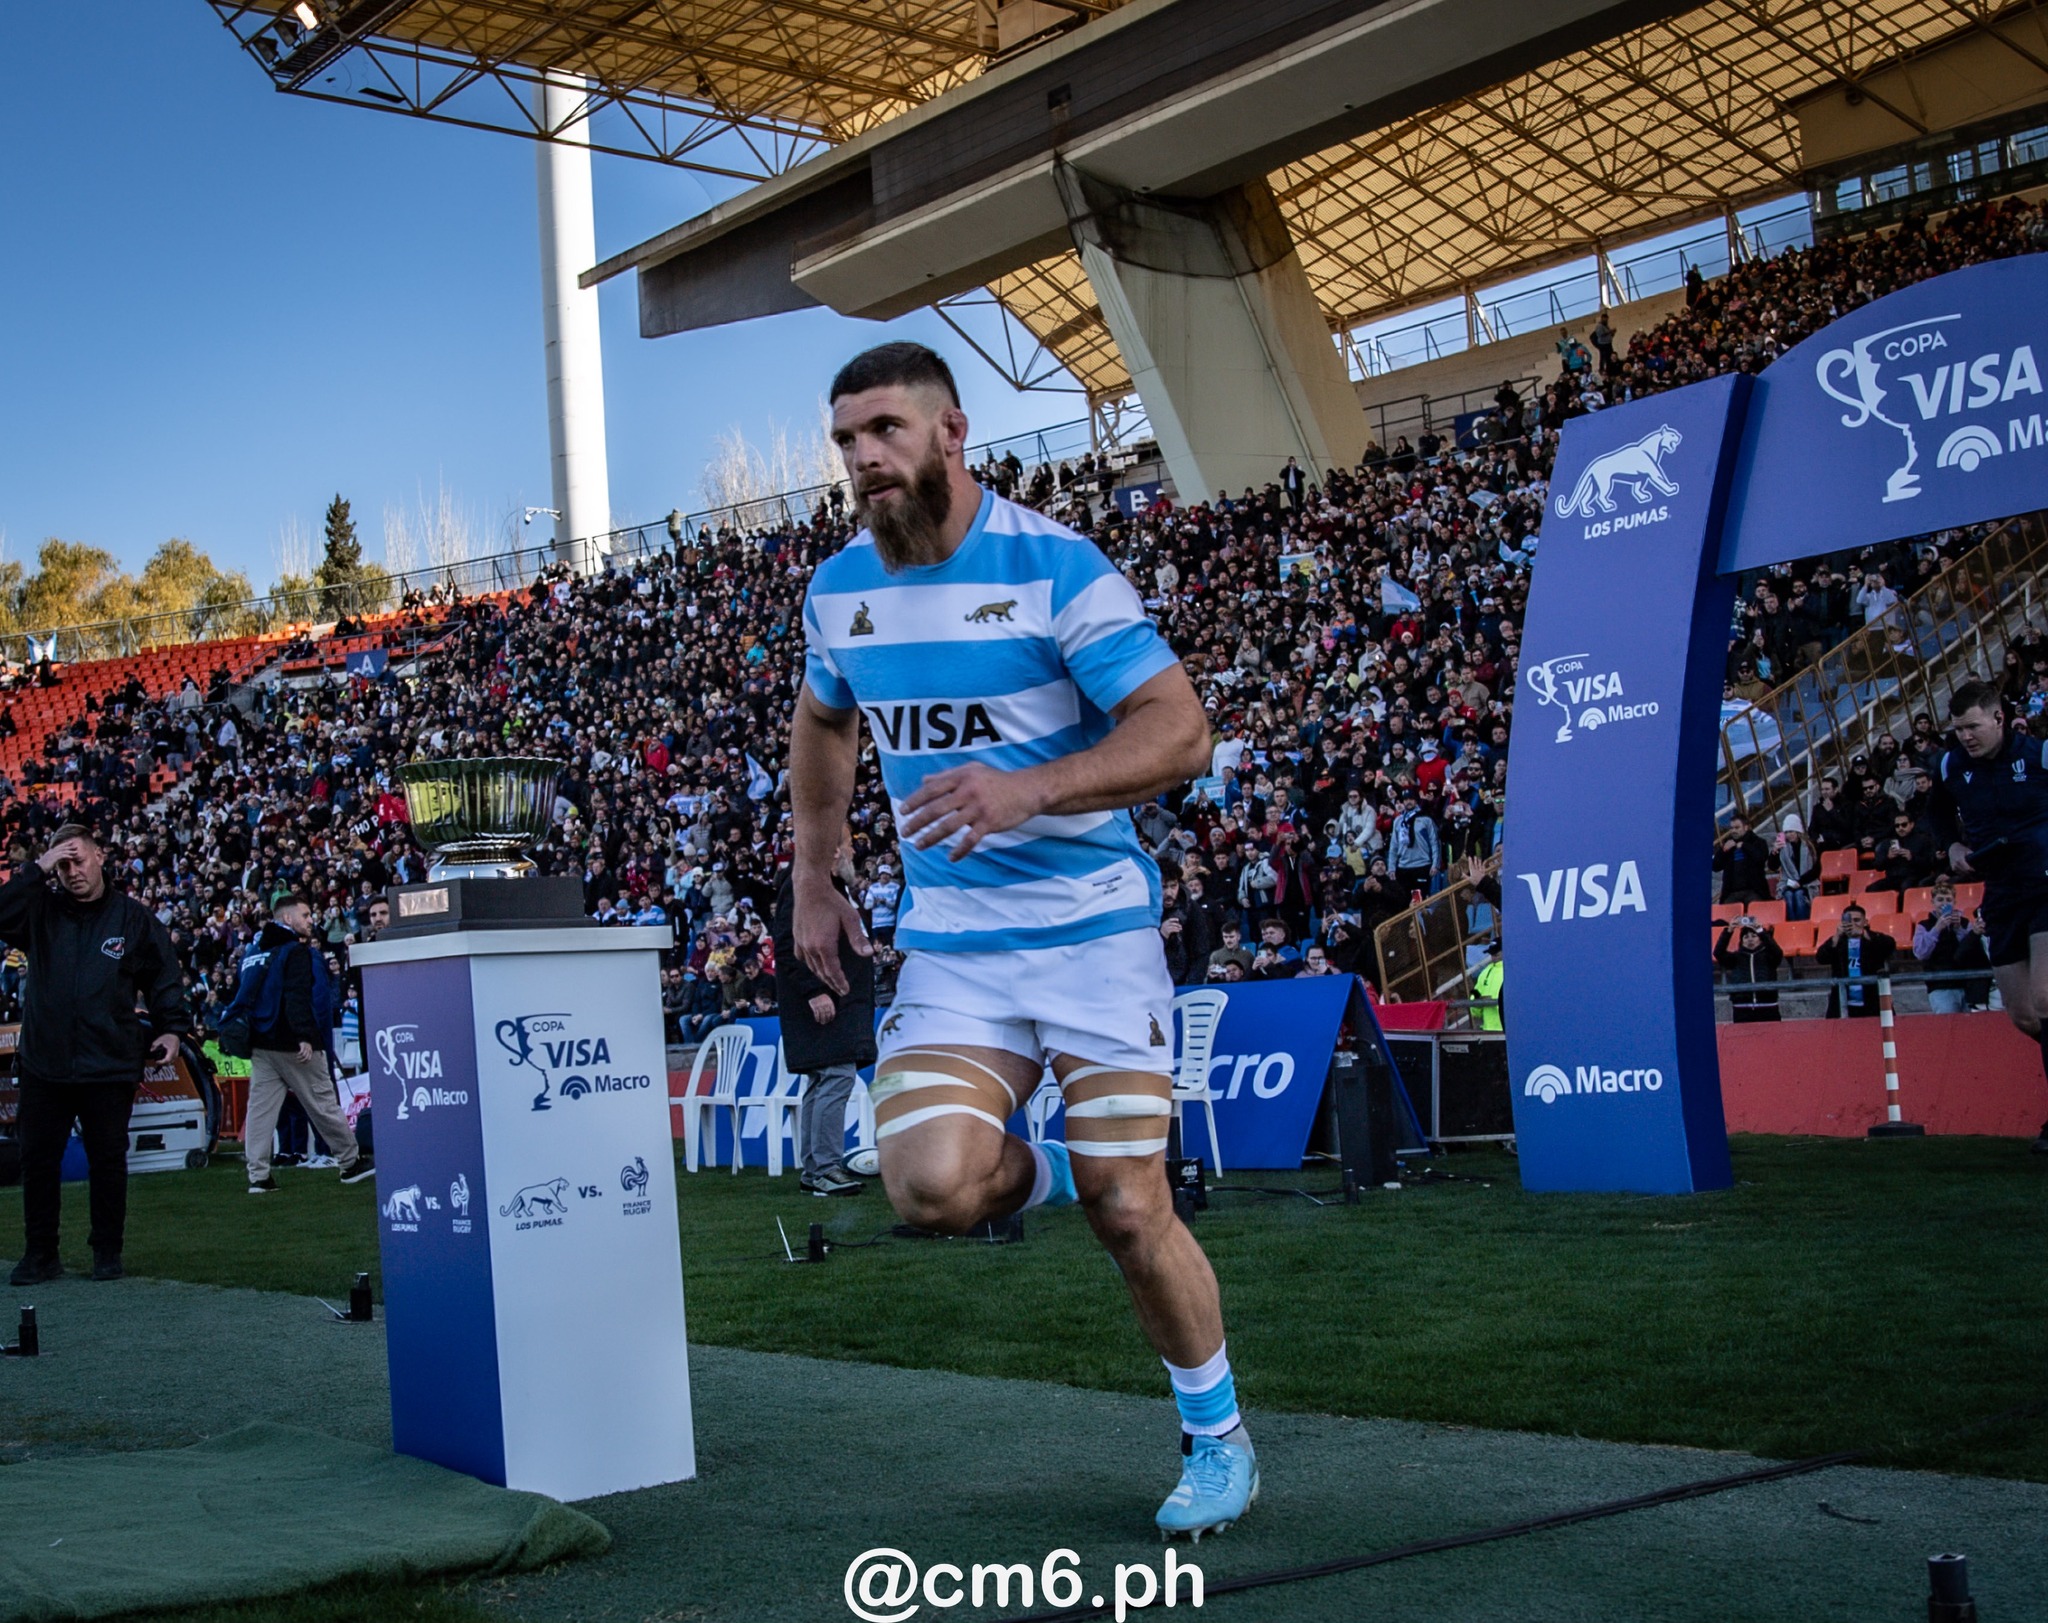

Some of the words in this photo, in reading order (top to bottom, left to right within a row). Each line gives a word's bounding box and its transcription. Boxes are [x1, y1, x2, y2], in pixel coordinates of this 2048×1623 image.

[1884, 330, 1948, 361] COPA
[1897, 345, 2043, 420] VISA
[1130, 489, 1145, 512] B
[1584, 521, 1611, 540] LOS
[1613, 506, 1668, 533] PUMAS
[361, 654, 376, 675] A
[1556, 661, 1584, 675] COPA
[1561, 671, 1624, 705] VISA
[1608, 702, 1659, 723] Macro
[864, 703, 1002, 751] VISA
[1516, 860, 1647, 924] VISA
[395, 1032, 415, 1044] COPA
[532, 1021, 565, 1033] COPA
[400, 1050, 443, 1079] VISA
[539, 1037, 611, 1069] VISA
[595, 1074, 651, 1093] Macro
[1173, 1051, 1295, 1101] cro
[1576, 1066, 1663, 1094] Macro
[432, 1088, 469, 1106] Macro
[622, 1200, 651, 1209] FRANCE
[623, 1207, 651, 1216] RUGBY
[515, 1221, 531, 1231] LOS
[533, 1218, 563, 1229] PUMAS
